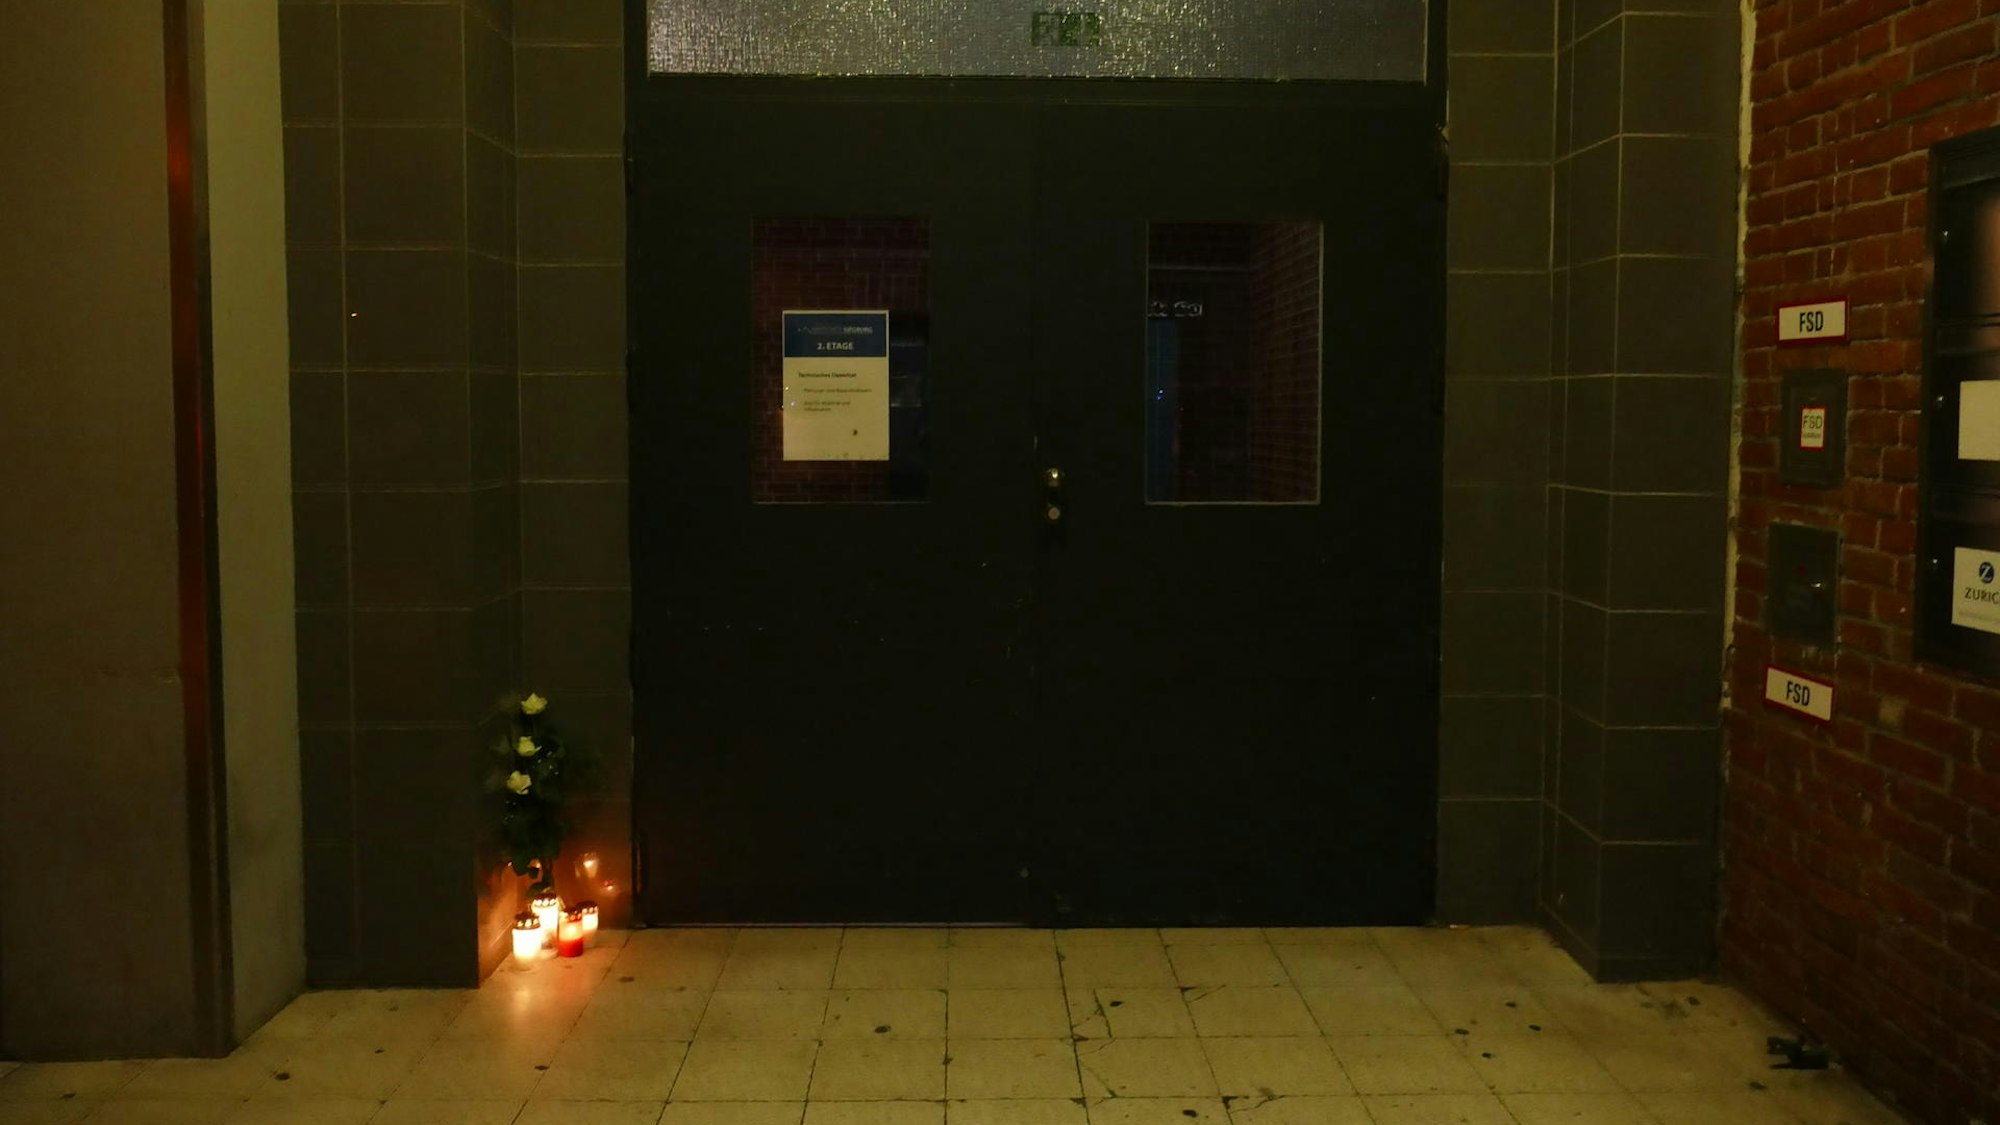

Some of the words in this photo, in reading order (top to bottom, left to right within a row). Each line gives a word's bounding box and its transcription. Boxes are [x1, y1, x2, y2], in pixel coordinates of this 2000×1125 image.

[1799, 311, 1824, 332] FSD
[826, 341, 854, 350] ETAGE
[1803, 415, 1823, 429] FSD
[1786, 680, 1810, 706] FSD
